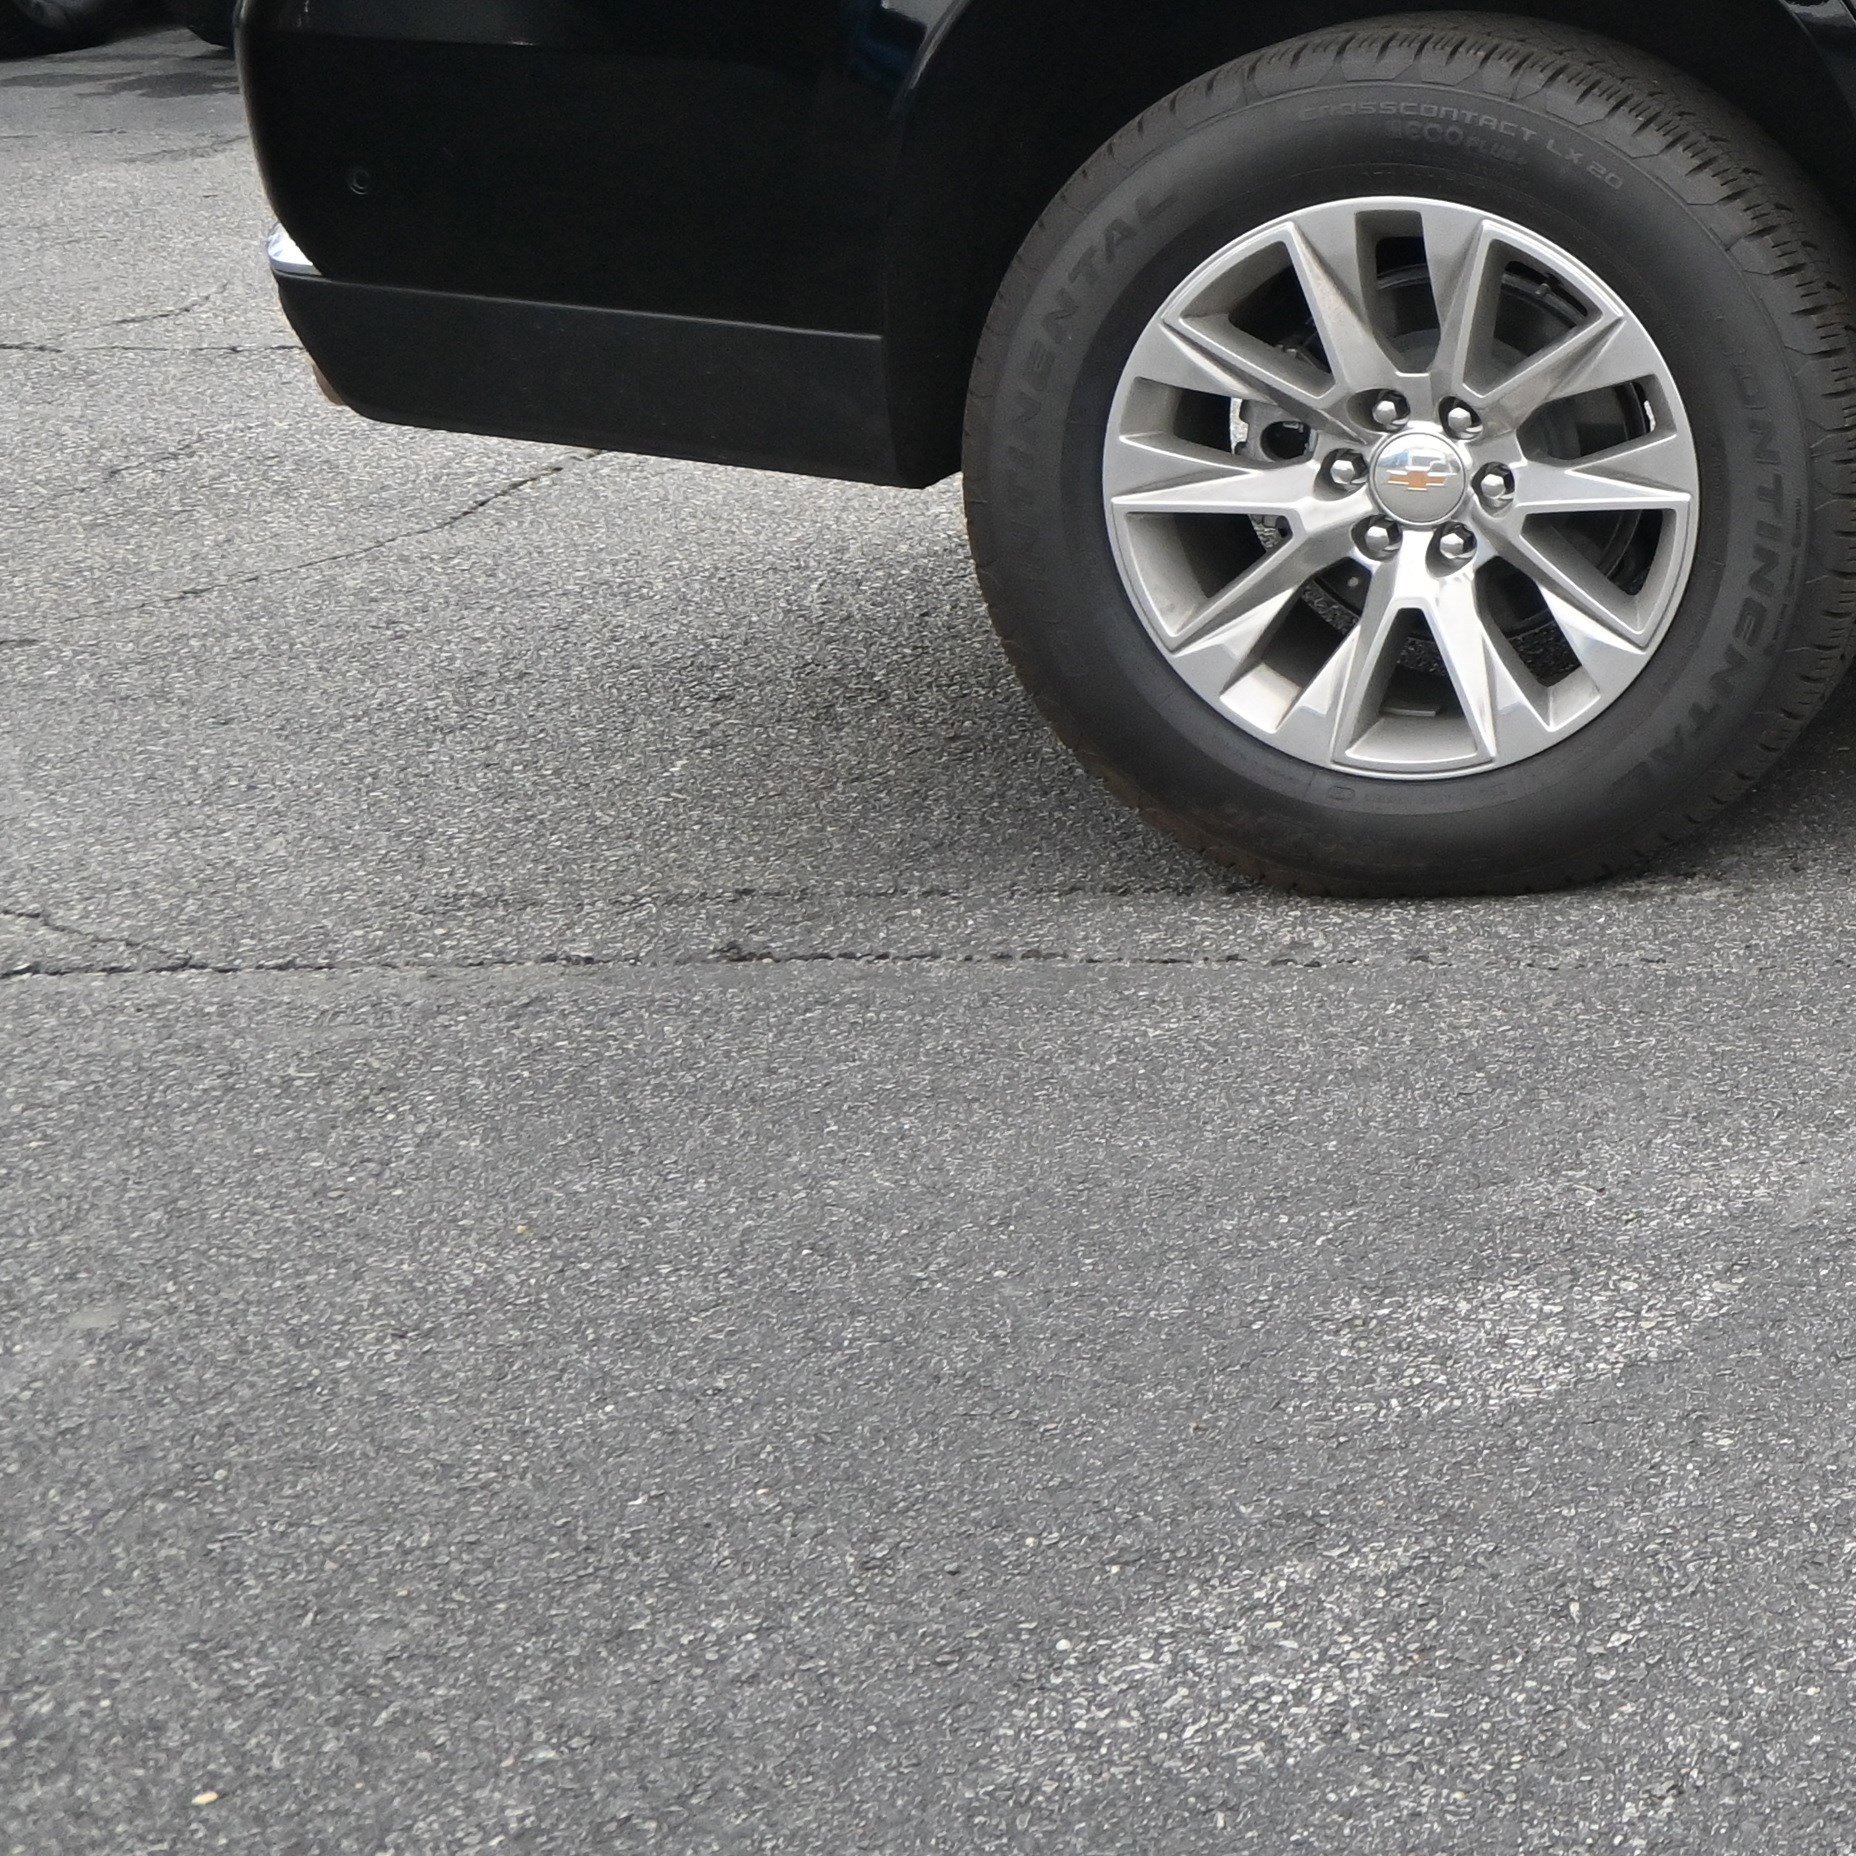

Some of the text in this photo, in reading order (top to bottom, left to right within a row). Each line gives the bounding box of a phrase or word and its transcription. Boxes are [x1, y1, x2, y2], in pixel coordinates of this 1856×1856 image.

[1299, 99, 1625, 190] CROSSCONTACT LX 20
